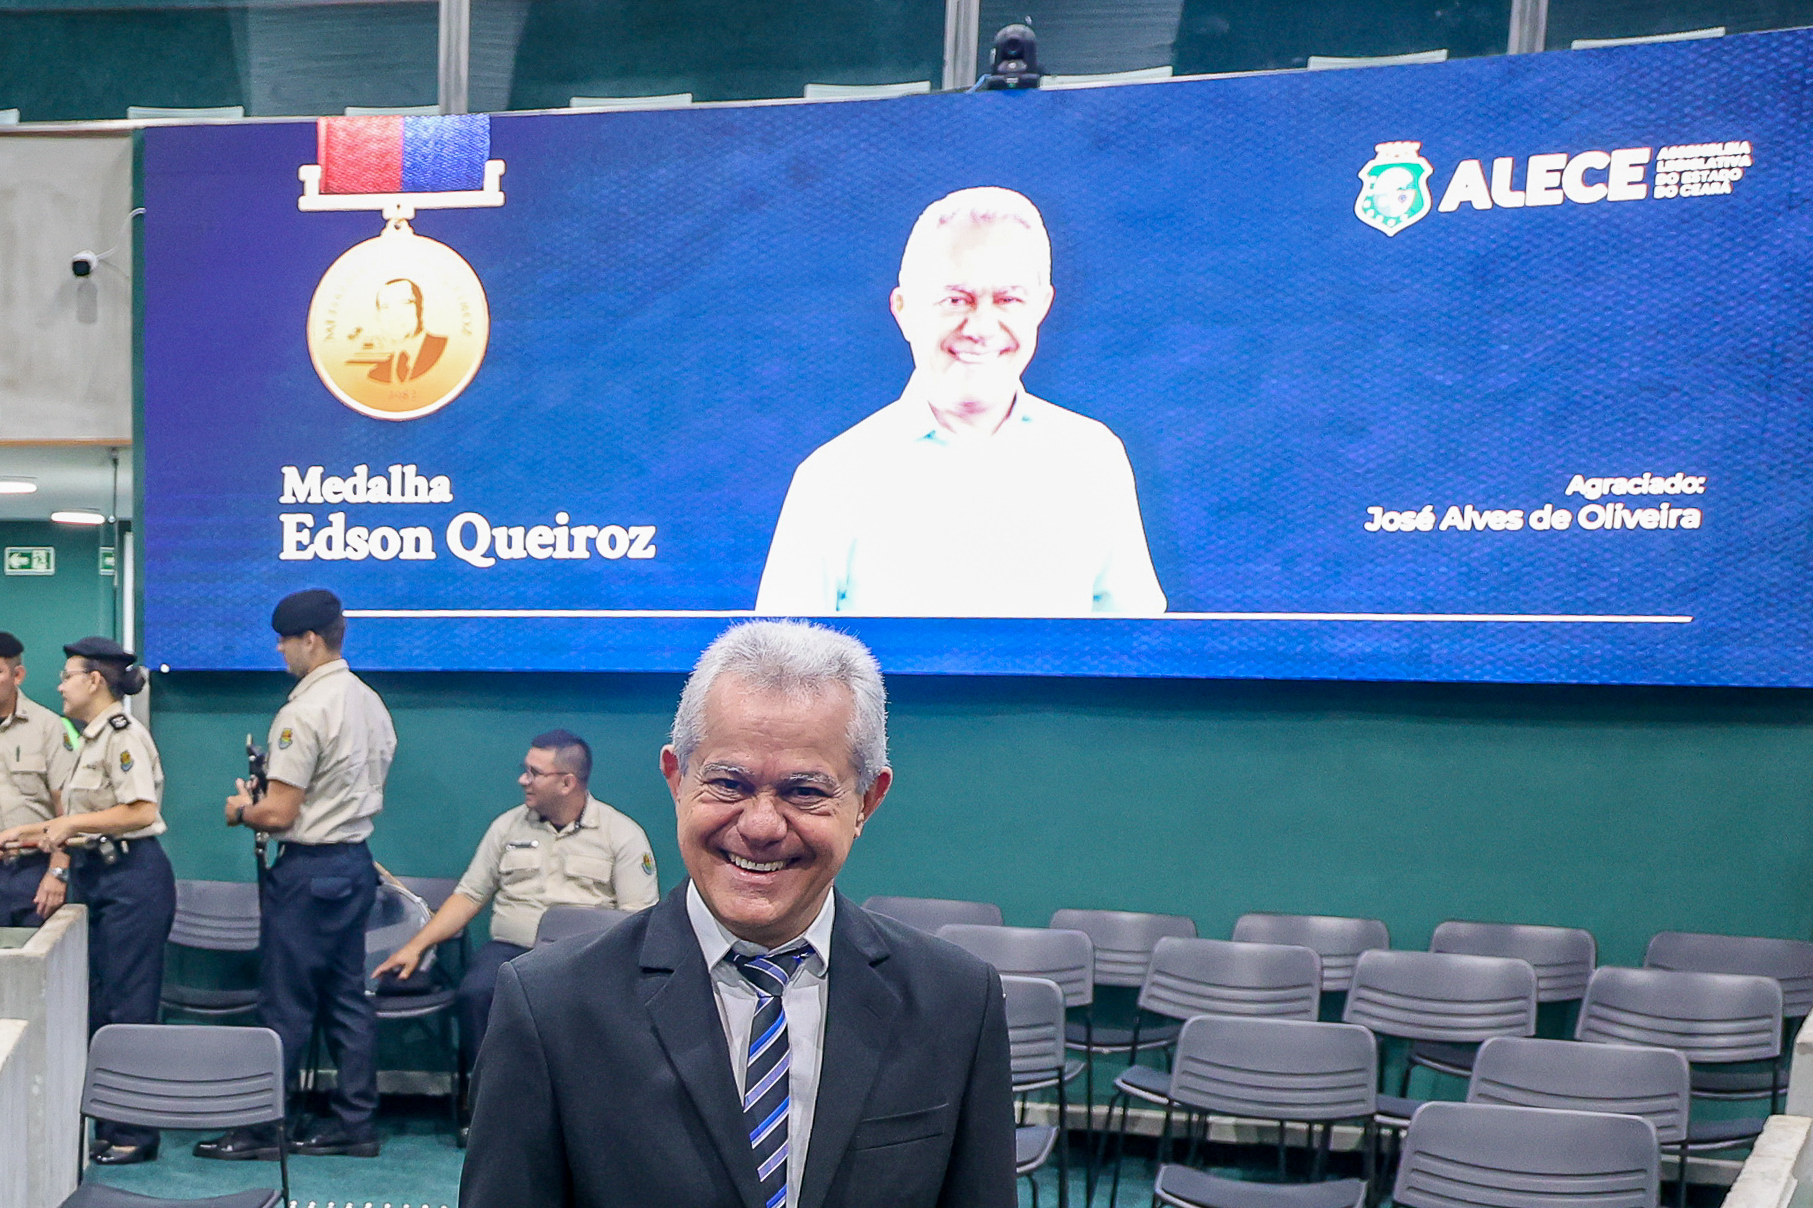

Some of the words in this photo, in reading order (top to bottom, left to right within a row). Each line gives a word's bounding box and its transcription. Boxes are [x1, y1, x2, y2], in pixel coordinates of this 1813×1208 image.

[1438, 148, 1651, 212] ALECE
[1655, 172, 1680, 185] DO
[1681, 167, 1743, 184] ESTADO
[1654, 185, 1679, 198] DO
[280, 465, 453, 503] Medalha
[1566, 473, 1706, 500] Agraciado:
[1365, 504, 1435, 531] José
[1439, 505, 1523, 531] Alves
[1529, 504, 1572, 530] de
[1578, 503, 1701, 530] Oliveira
[280, 512, 436, 560] Edson
[447, 512, 656, 567] Queiroz
